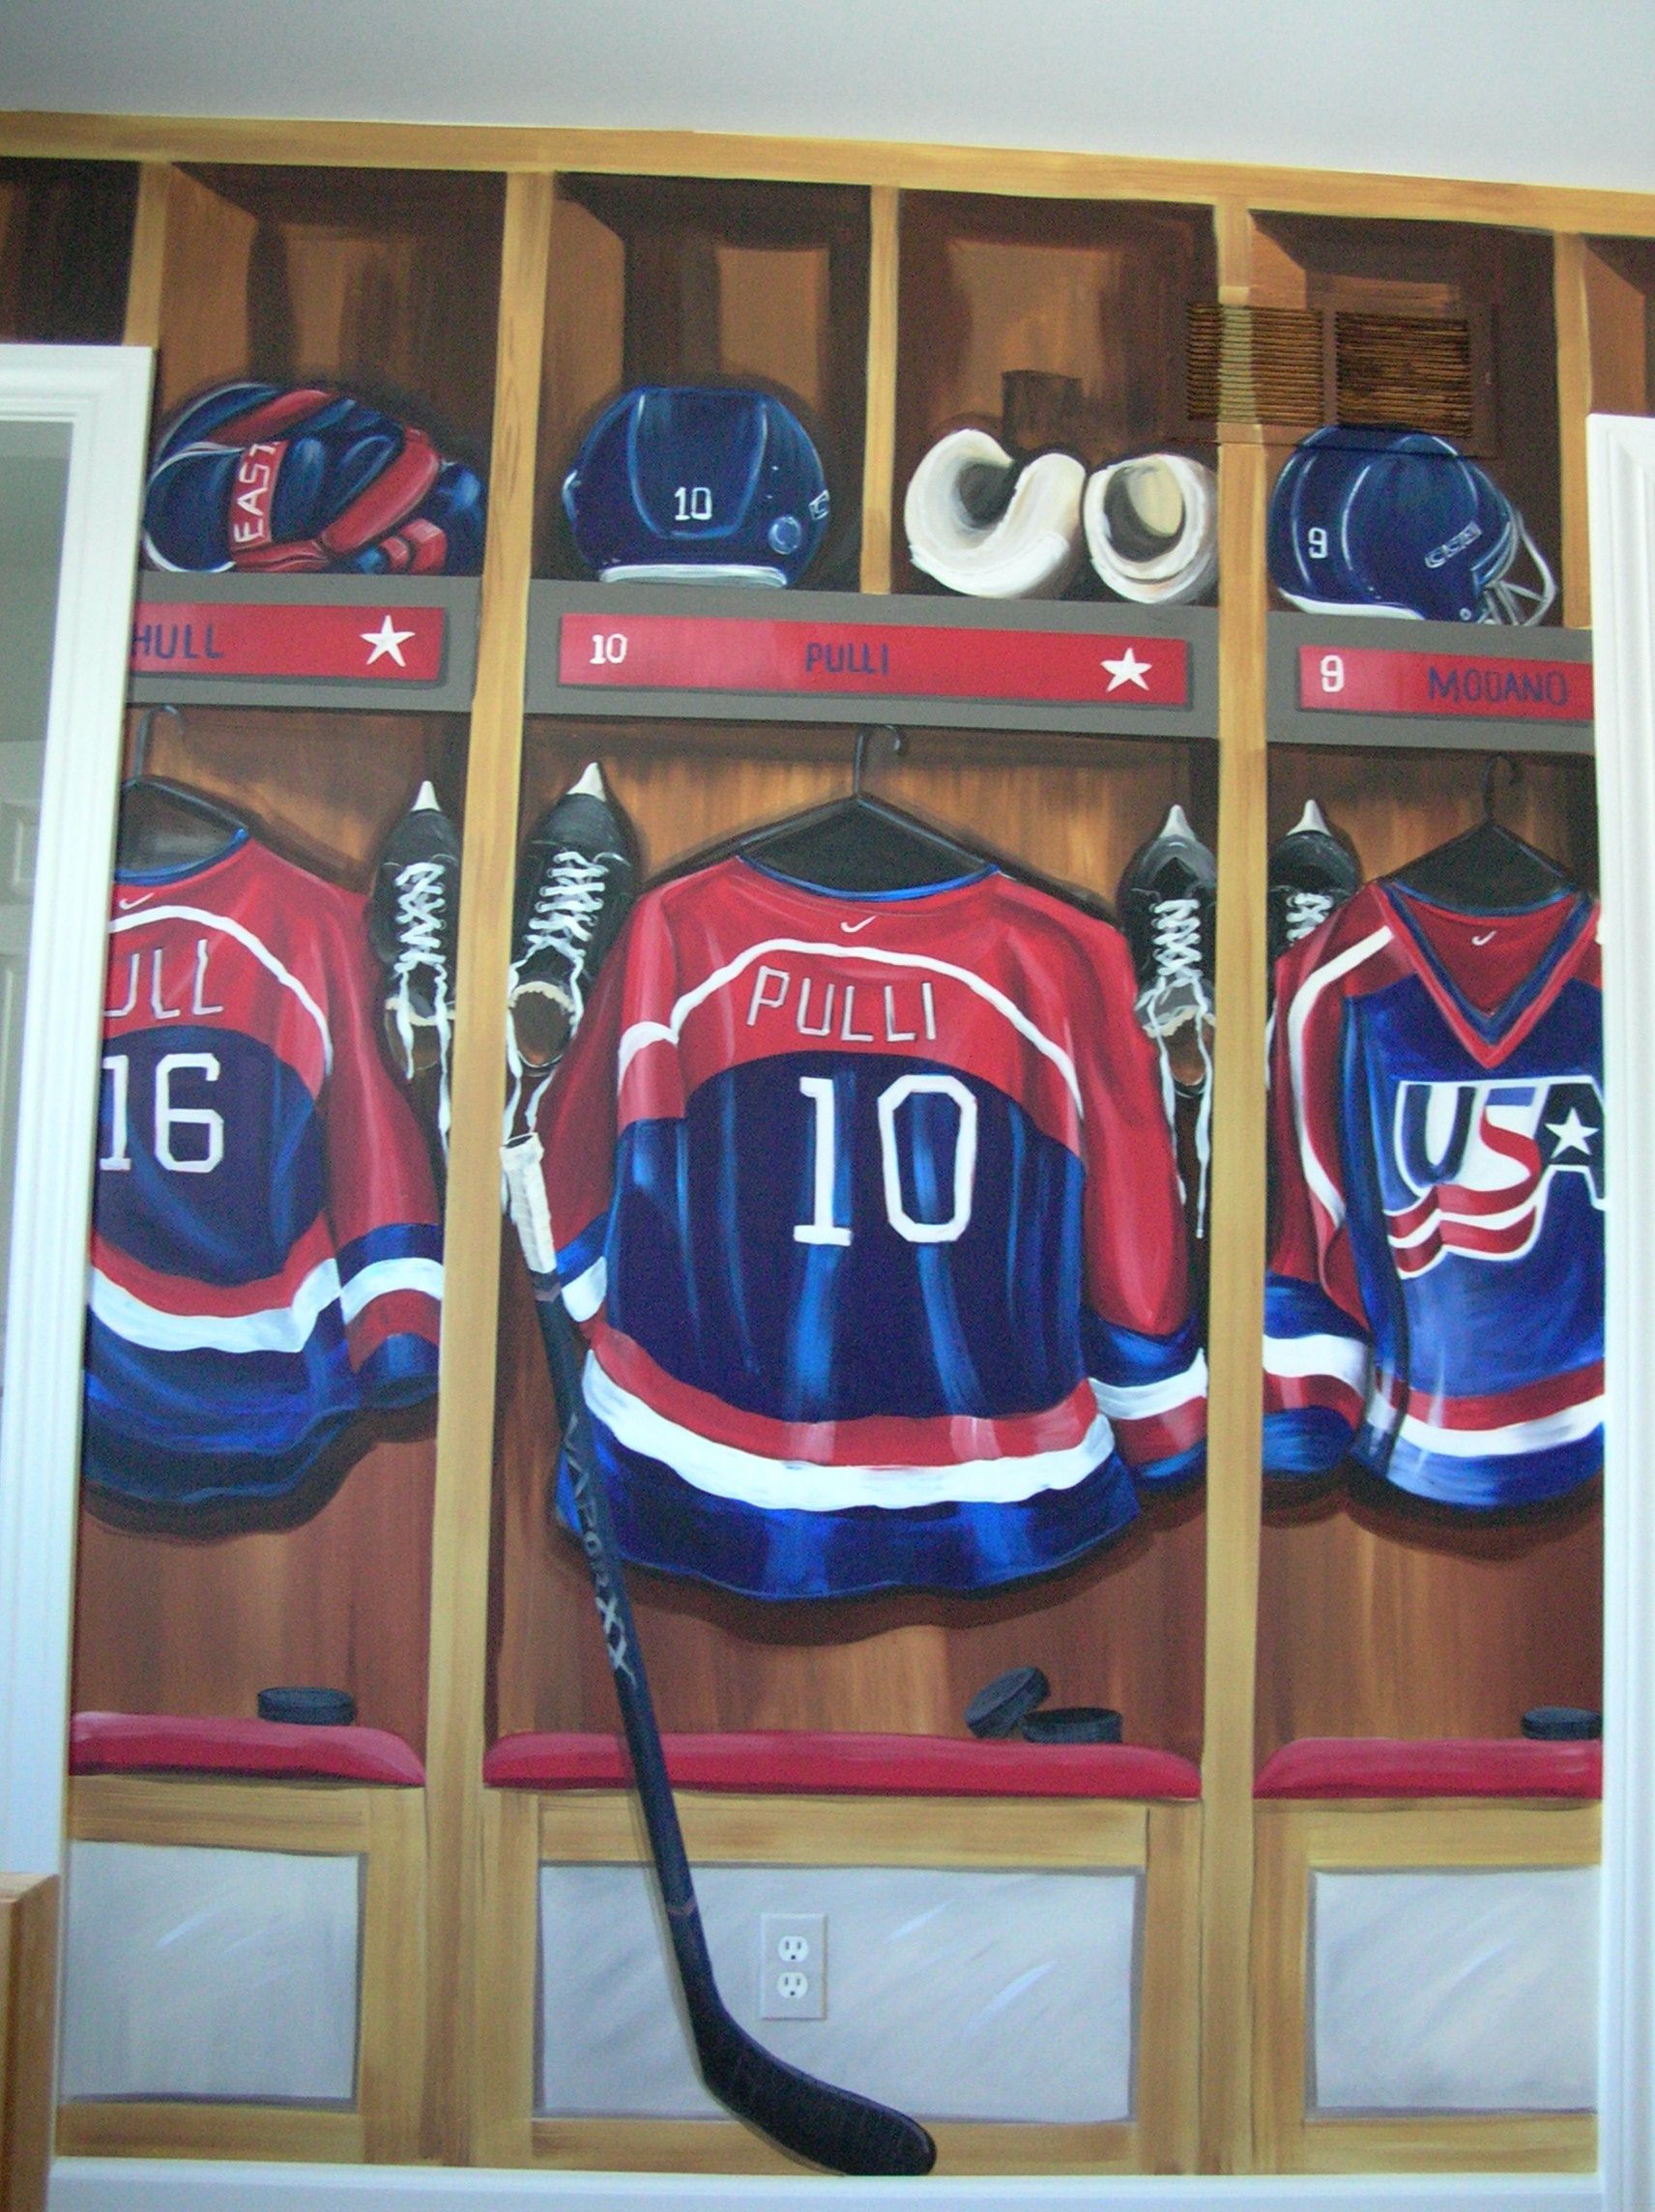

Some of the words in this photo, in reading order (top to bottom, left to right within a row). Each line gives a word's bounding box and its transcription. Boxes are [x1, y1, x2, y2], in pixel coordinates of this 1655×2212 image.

[673, 485, 713, 522] 10
[1307, 527, 1329, 560] 9
[131, 624, 223, 658] HULL
[589, 633, 628, 665] 10
[805, 642, 888, 676] PULLI
[1320, 655, 1345, 693] 9
[746, 966, 937, 1042] PULLI
[101, 1052, 224, 1174] 16
[793, 1073, 978, 1247] 10
[1384, 1075, 1606, 1280] USA
